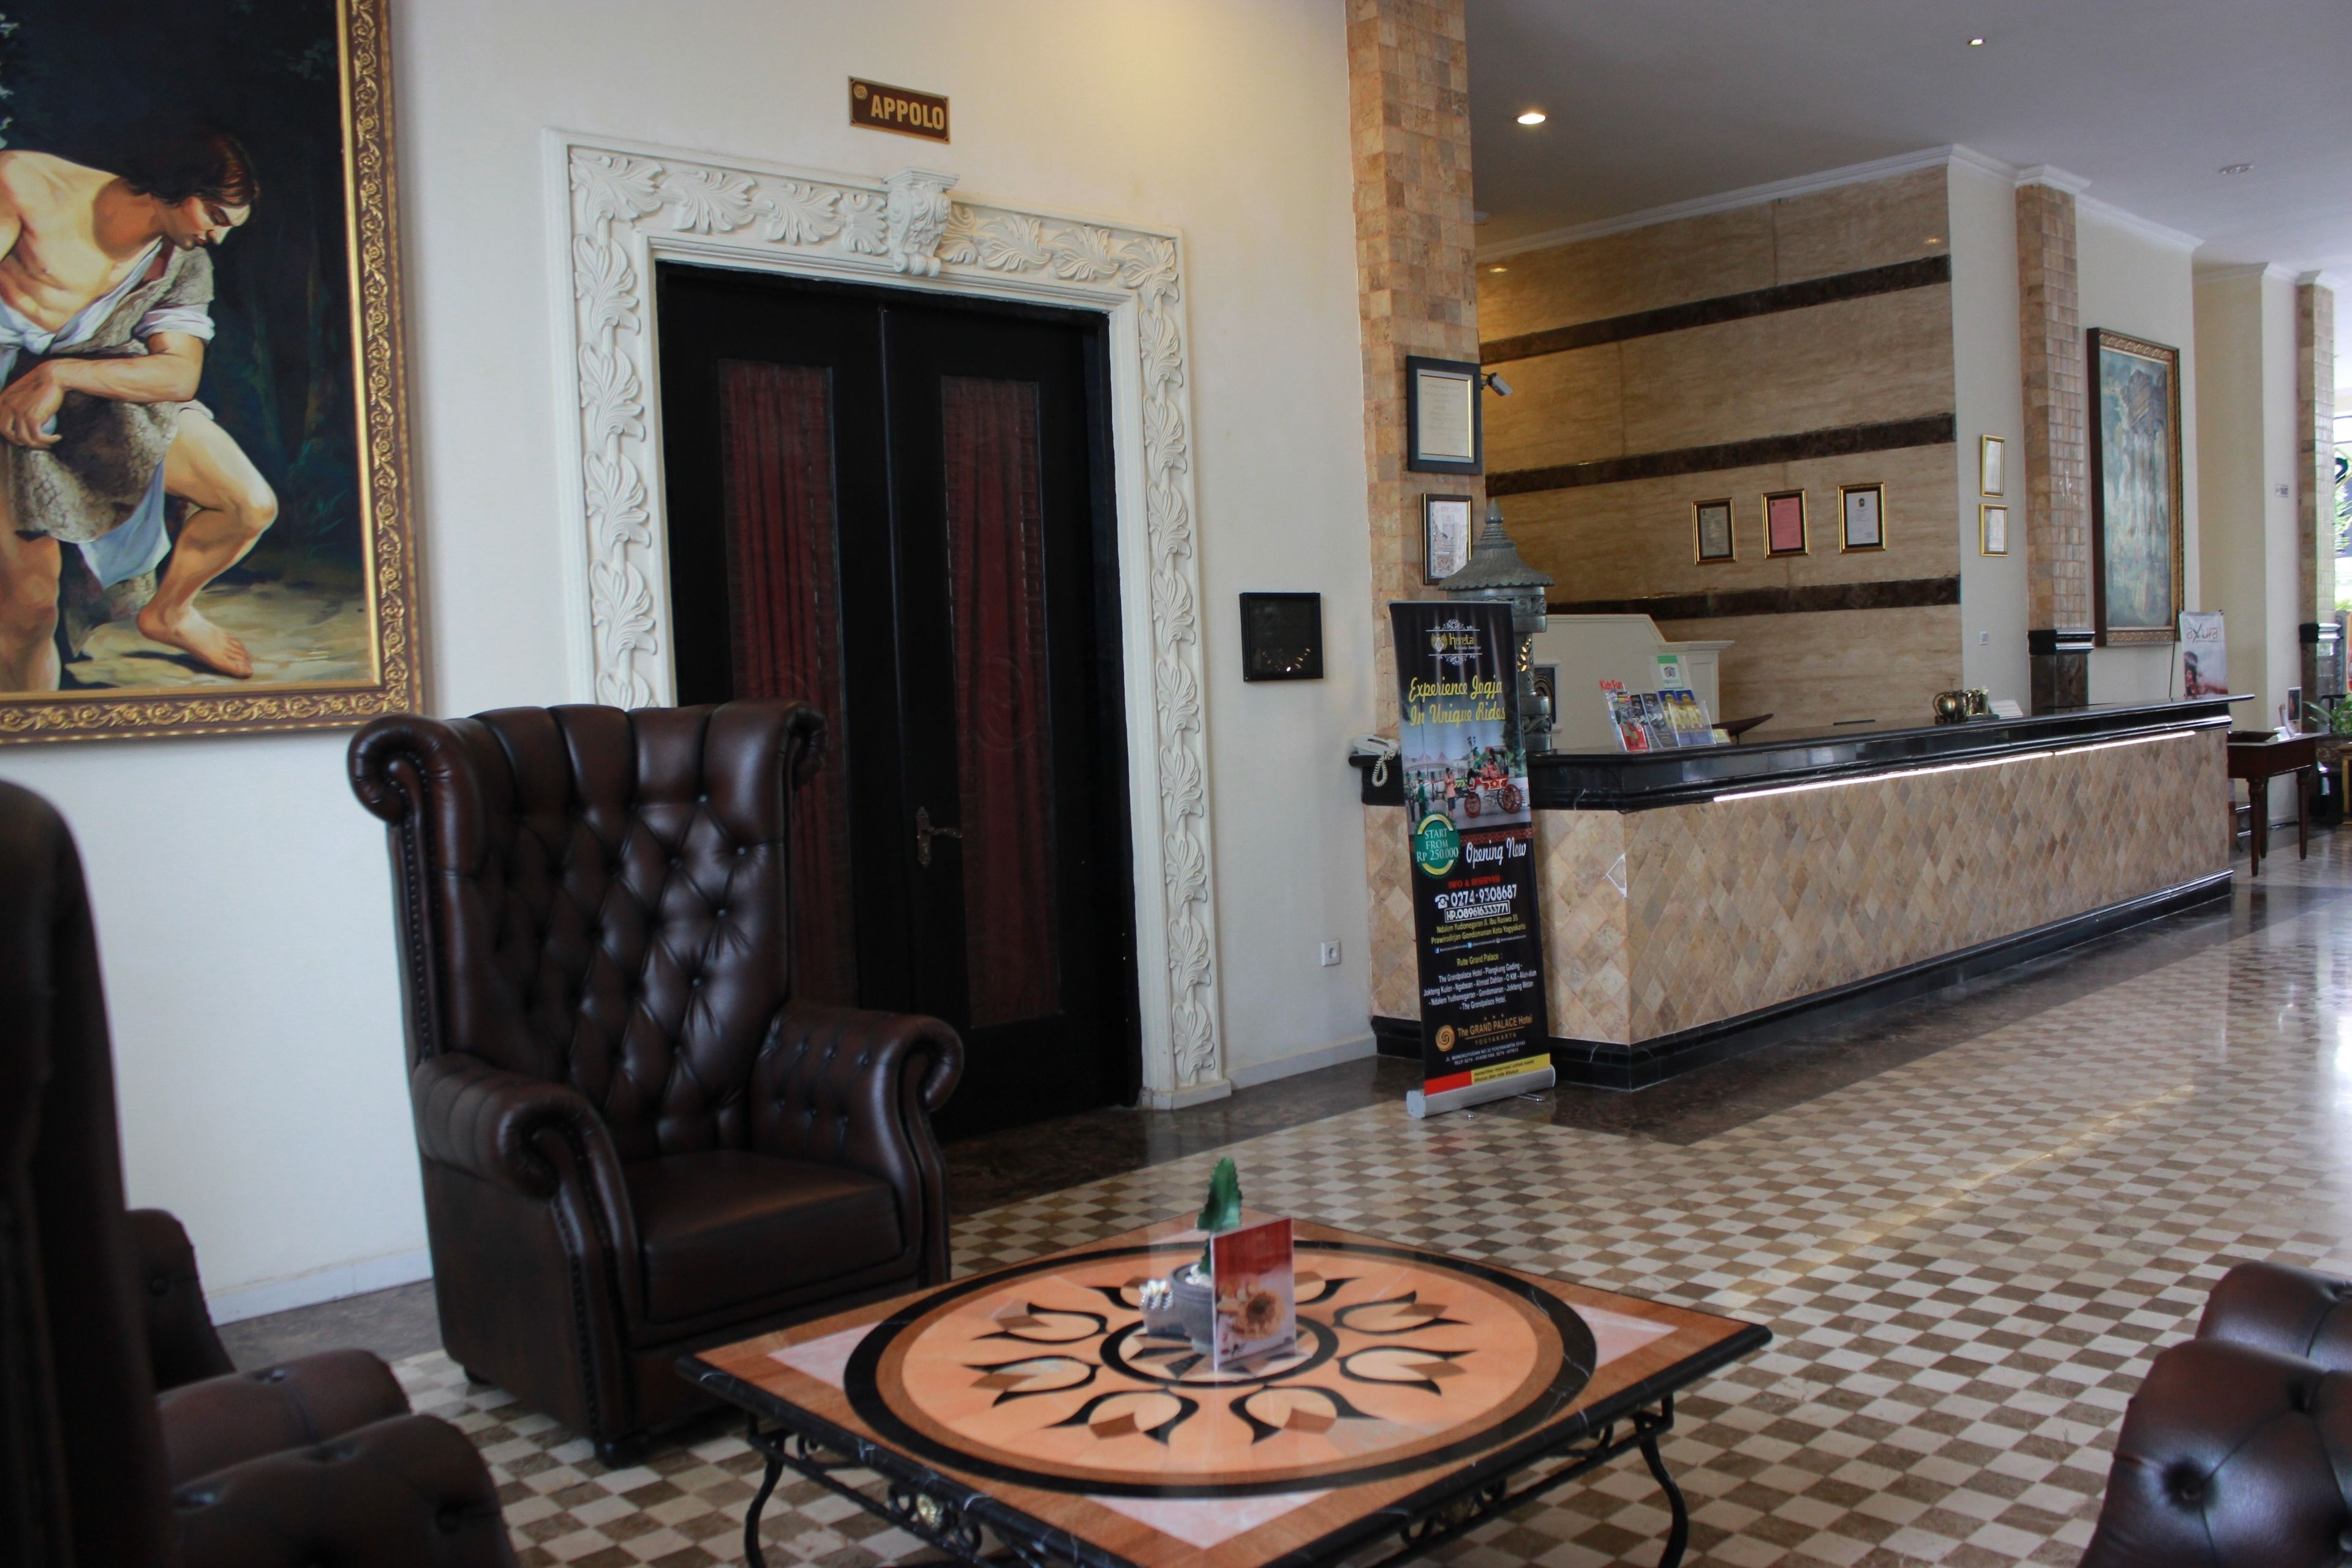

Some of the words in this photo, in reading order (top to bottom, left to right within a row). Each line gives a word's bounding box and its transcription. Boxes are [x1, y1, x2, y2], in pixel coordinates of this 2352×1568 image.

[870, 94, 944, 130] APPOLO
[1409, 676, 1468, 703] Experience
[1470, 674, 1502, 699] Jogja
[1410, 705, 1425, 726] In
[1430, 703, 1472, 729] Unique
[1476, 701, 1506, 721] Rides
[1425, 828, 1447, 840] START
[1426, 839, 1449, 850] FROM
[1430, 847, 1459, 861] 250.000
[1466, 840, 1504, 869] Opening
[1506, 837, 1526, 858] Now
[1457, 957, 1468, 967] Rute
[1469, 955, 1483, 963] Grand
[1483, 952, 1499, 961] Palace
[1472, 968, 1482, 977] Hotel
[1457, 1027, 1469, 1038] The
[1469, 1022, 1492, 1035] GRAND
[1493, 1017, 1517, 1030] PALACE
[1518, 1014, 1533, 1025] Hotel
[1474, 1032, 1517, 1046] YOGYAKARTA
